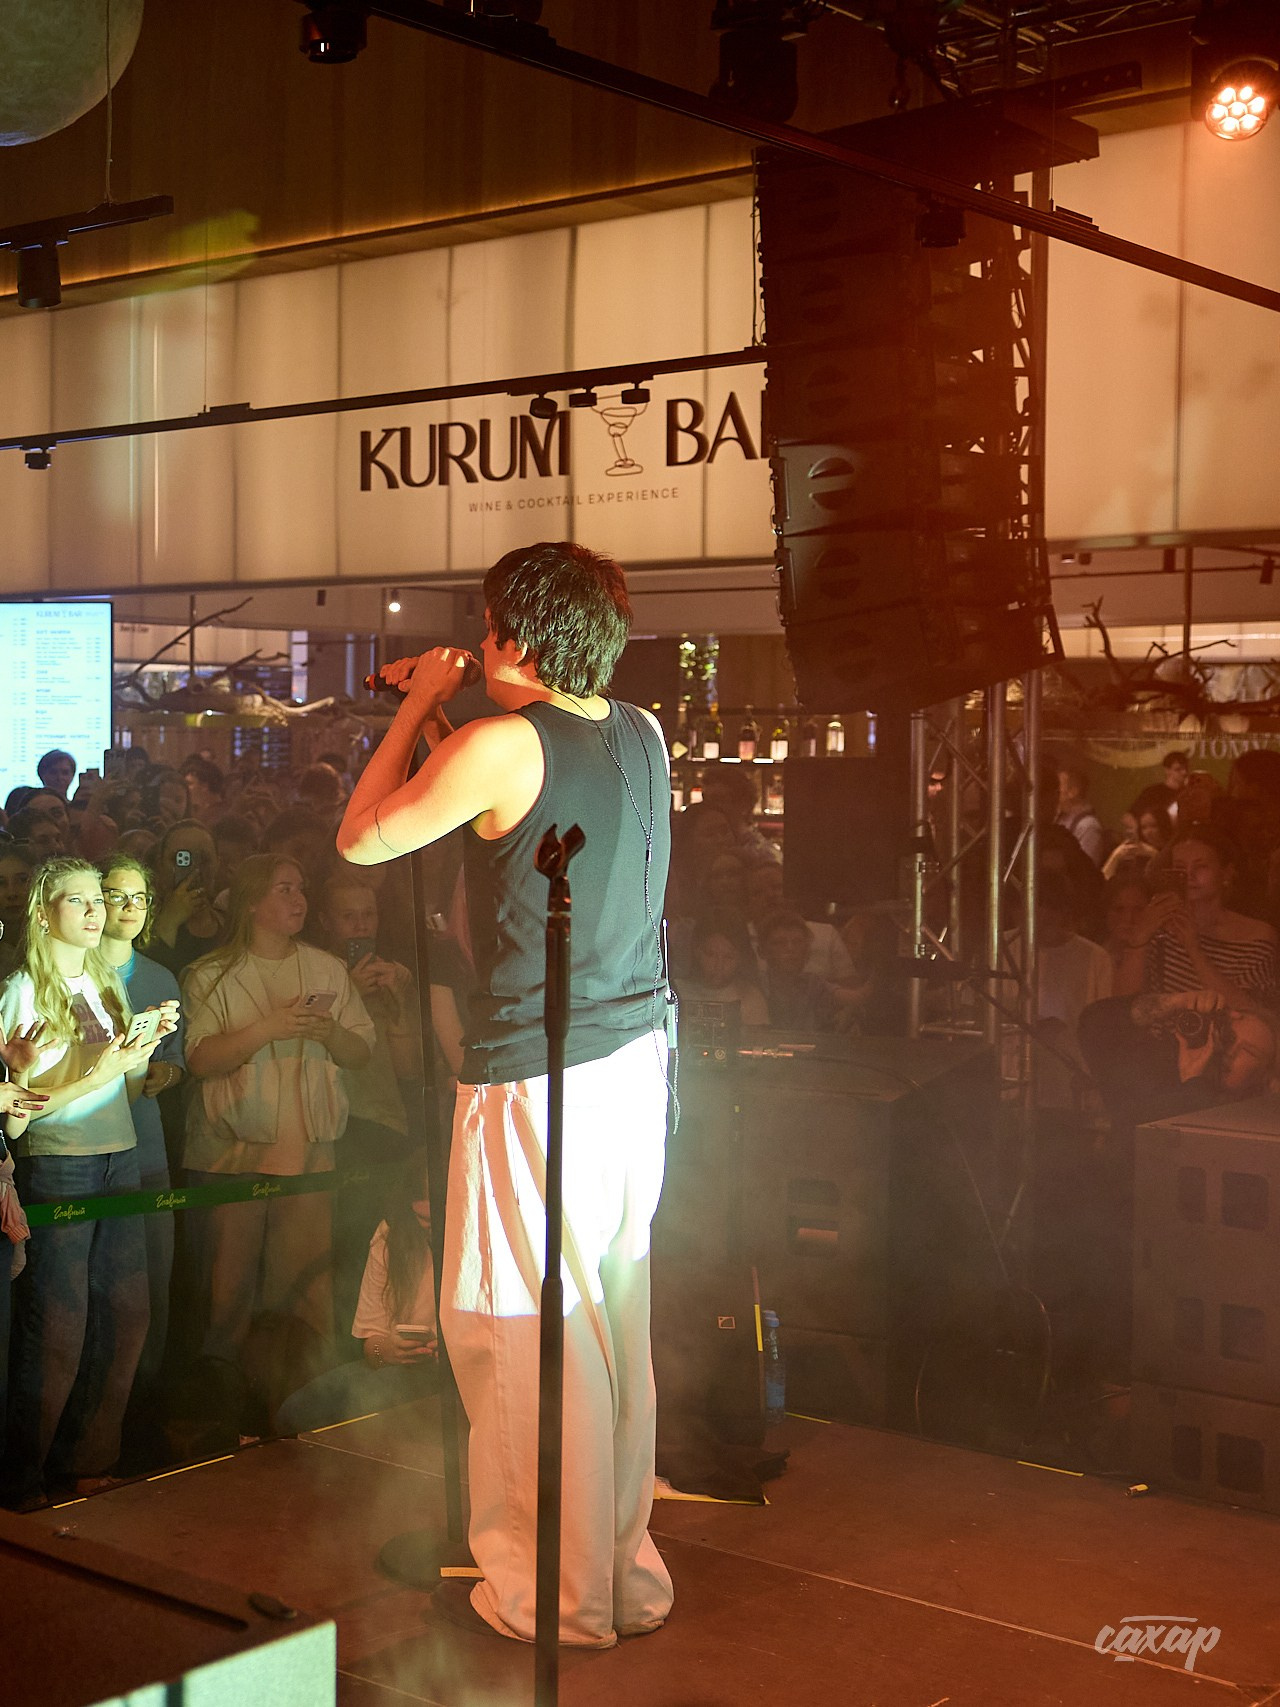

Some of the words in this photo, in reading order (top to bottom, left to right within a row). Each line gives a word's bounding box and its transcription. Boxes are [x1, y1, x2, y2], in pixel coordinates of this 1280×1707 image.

[360, 411, 569, 491] KURUM
[469, 500, 502, 513] WINE
[505, 500, 513, 511] &
[519, 494, 582, 510] COCKTAIL
[588, 487, 680, 505] EXPERIENCE
